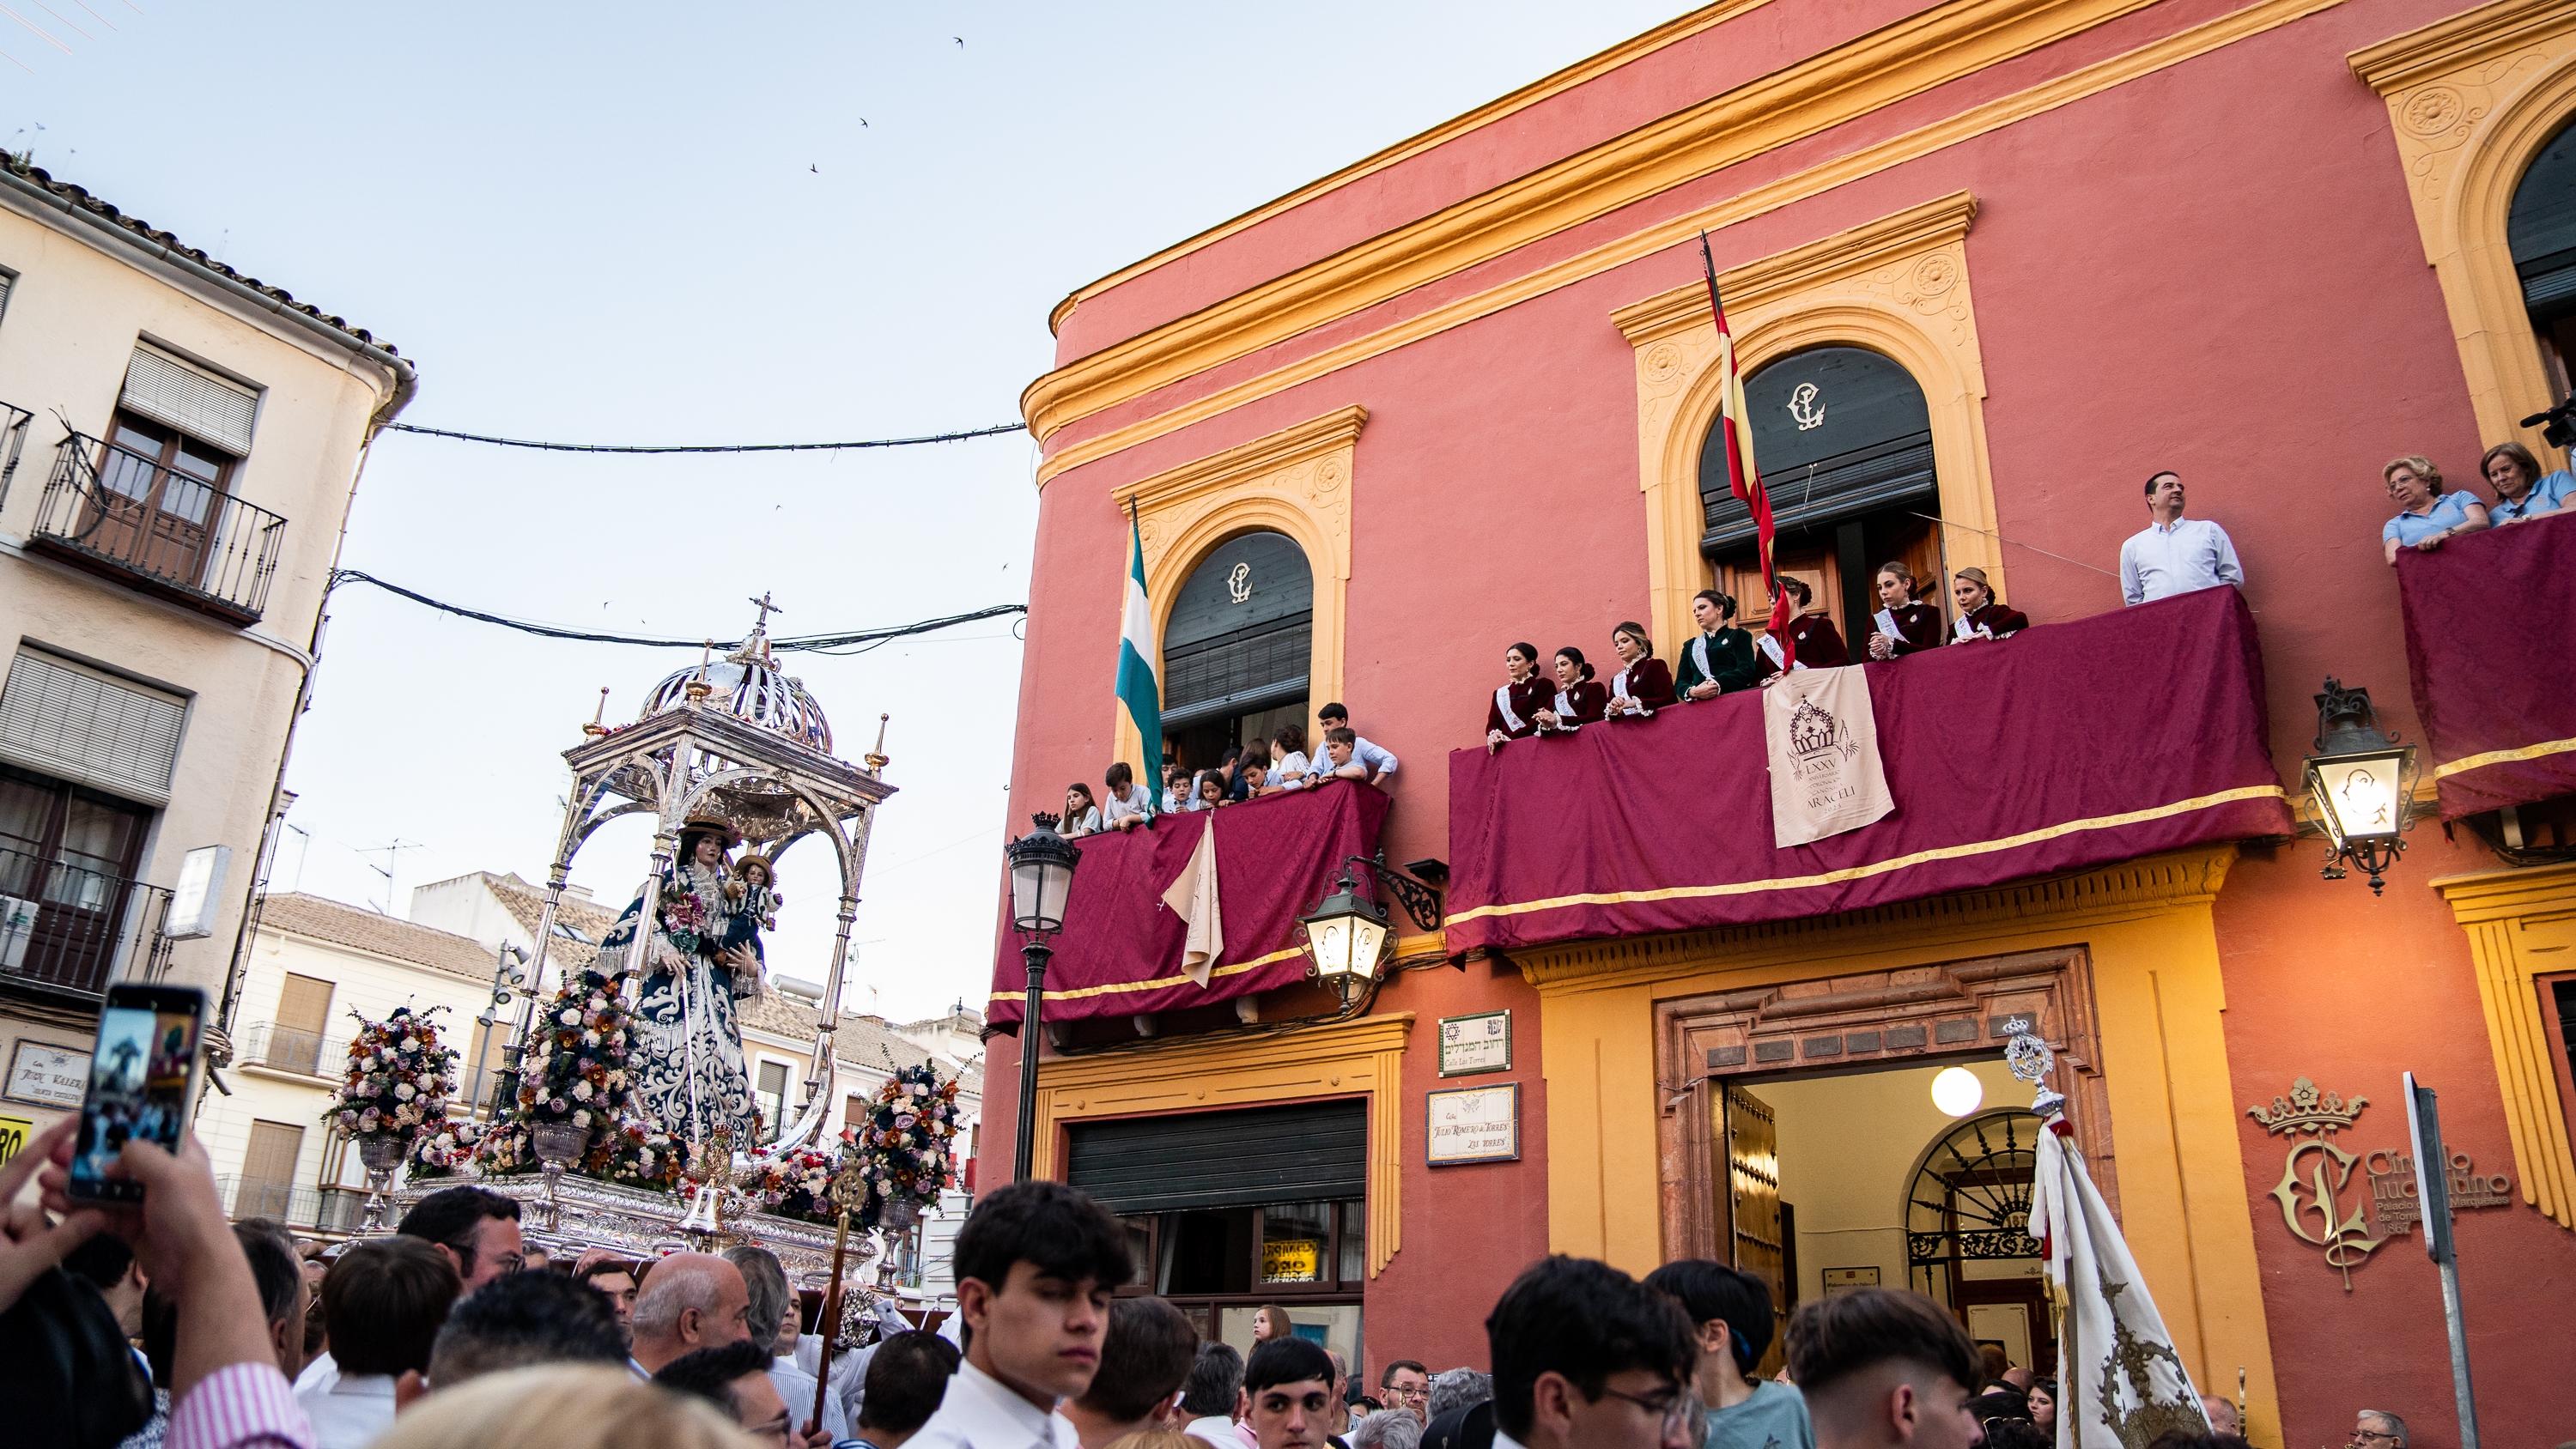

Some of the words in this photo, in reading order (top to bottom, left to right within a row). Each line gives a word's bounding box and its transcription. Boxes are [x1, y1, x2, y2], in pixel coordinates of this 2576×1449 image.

[1806, 758, 1836, 774] LXXV
[1807, 785, 1855, 809] ARACELI
[1469, 1056, 1486, 1064] Torres
[2376, 1202, 2413, 1211] Palacio
[2449, 1196, 2509, 1209] Marqueses
